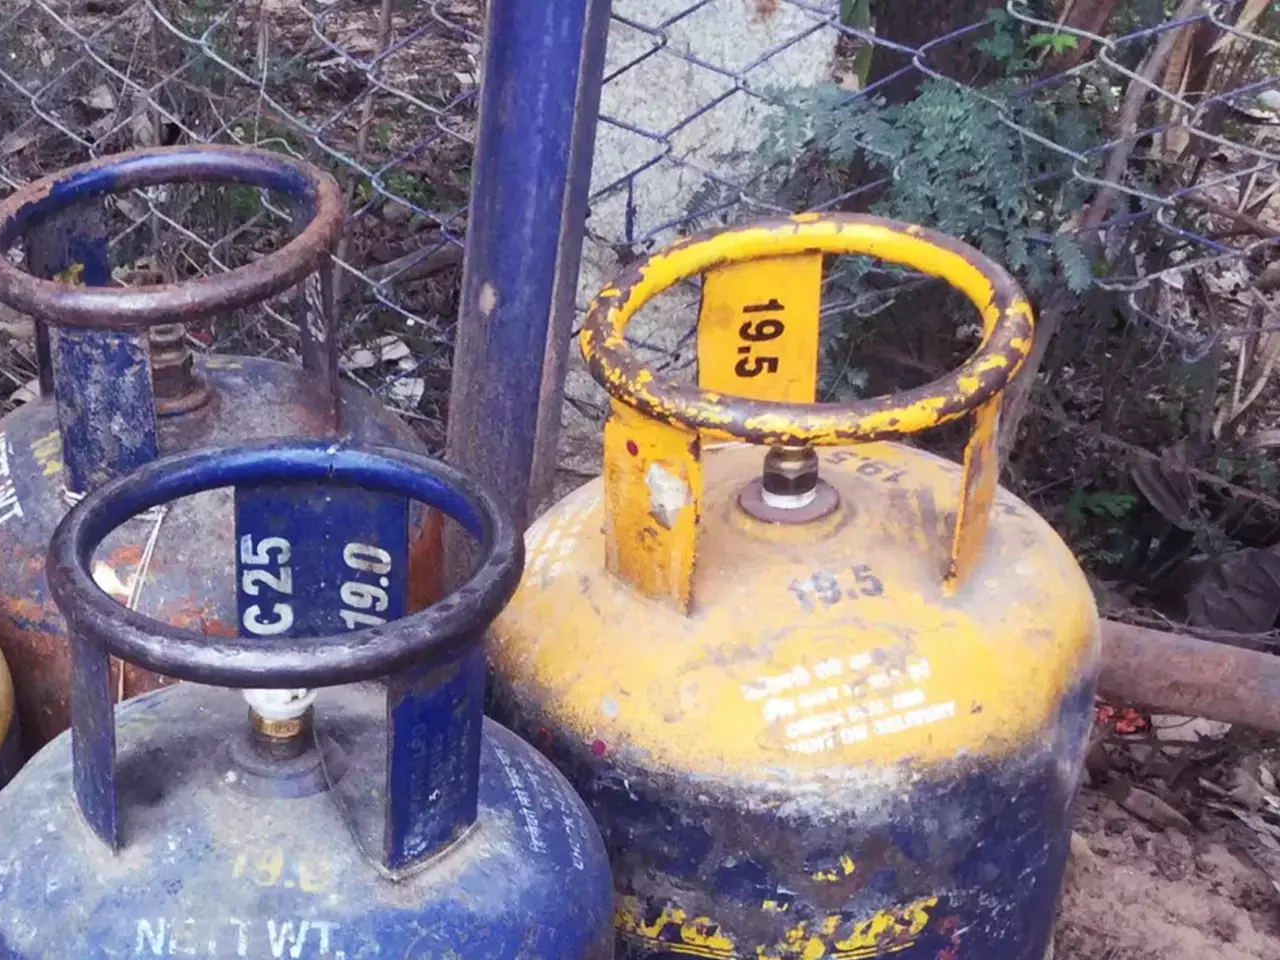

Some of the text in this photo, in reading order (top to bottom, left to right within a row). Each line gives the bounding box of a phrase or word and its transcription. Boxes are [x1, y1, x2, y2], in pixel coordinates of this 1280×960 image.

[734, 298, 785, 378] 19.5
[240, 533, 294, 636] C25
[338, 542, 392, 630] 19.0
[267, 918, 347, 960] WT.
